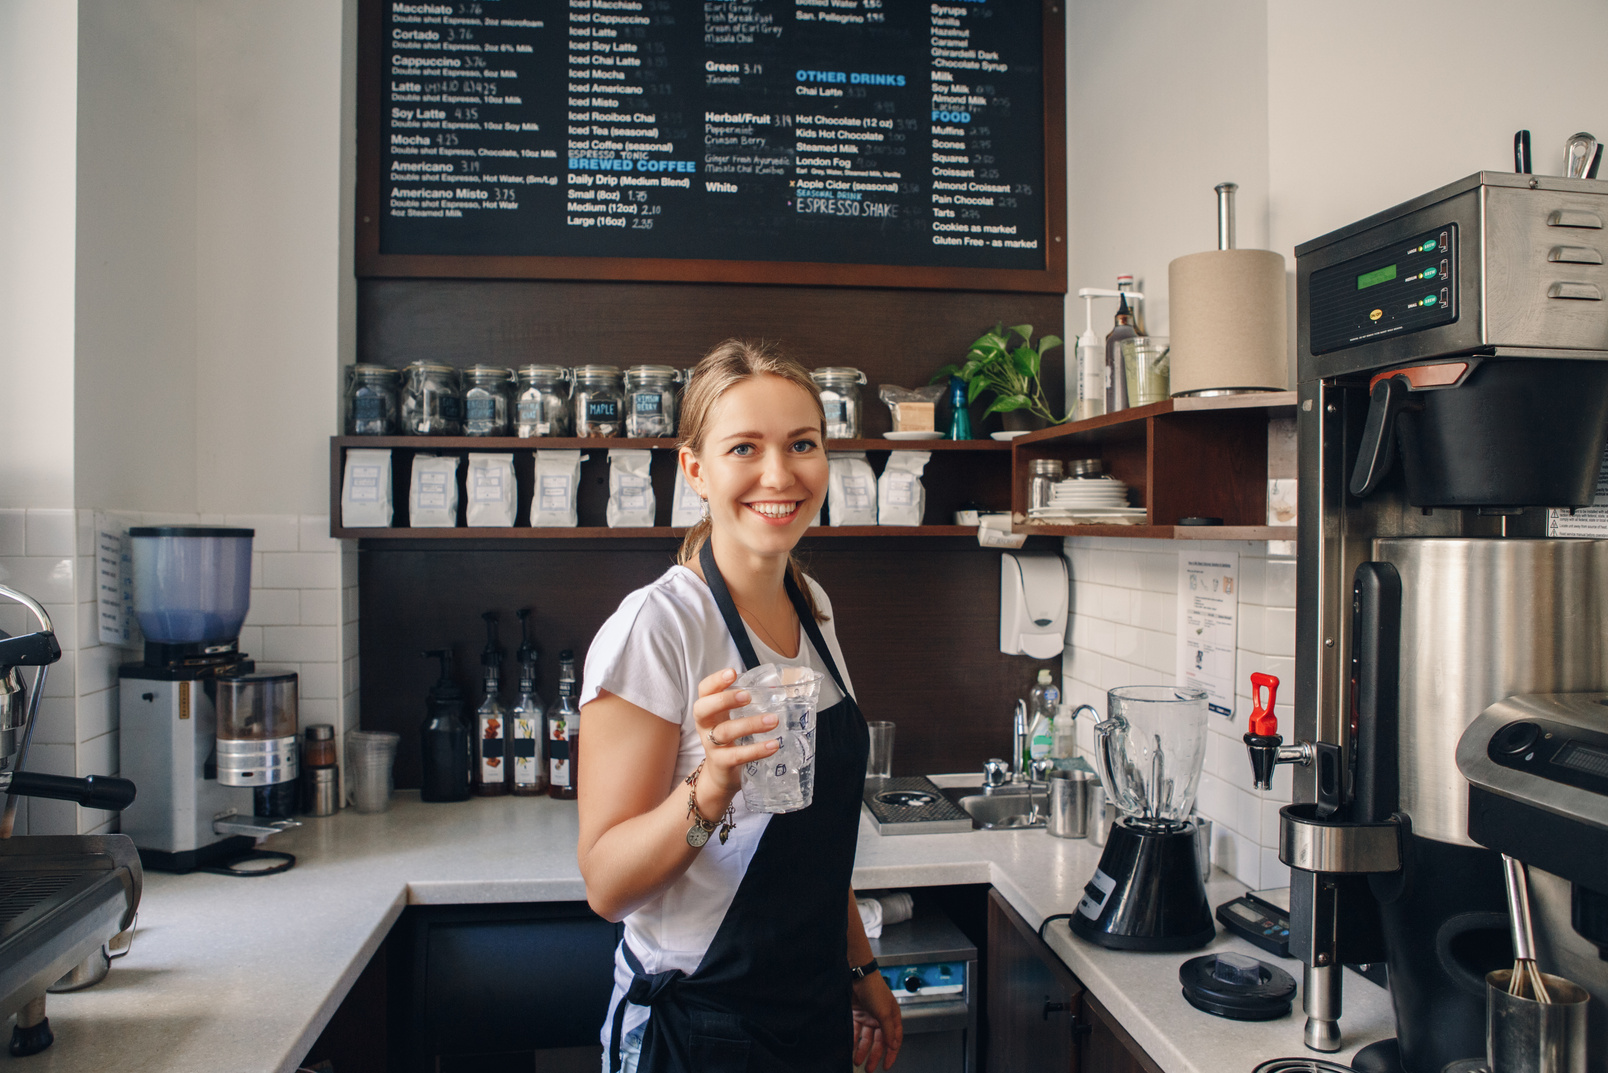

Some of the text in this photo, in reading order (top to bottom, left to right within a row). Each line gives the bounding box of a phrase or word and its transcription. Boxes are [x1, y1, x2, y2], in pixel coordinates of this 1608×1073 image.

[392, 3, 482, 15] Macchiato 3.76
[569, 0, 642, 10] Iced Macchiato
[704, 2, 753, 15] Earl Grey
[931, 4, 967, 16] Syrups
[569, 12, 650, 25] Iced Cappuccino
[705, 12, 773, 24] Irish Breakfast
[796, 10, 864, 24] San. Pellegrino
[931, 16, 960, 27] Vanilla
[392, 28, 474, 41] Cortado 3.76
[569, 26, 617, 38] Iced Latte
[732, 22, 740, 33] of
[742, 24, 759, 33] Earl
[761, 23, 782, 38] Grey
[931, 26, 970, 38] Hazelnut
[704, 33, 754, 43] Masala Chai
[931, 36, 968, 48] Caramel
[569, 40, 638, 53] Iced Soy Latte
[931, 47, 999, 60] Ghirardelli Dark
[392, 55, 486, 68] Cappuccino 3.76
[569, 54, 641, 66] Iced Chai Latte
[931, 58, 980, 70] -Chocolate
[981, 61, 1008, 73] Syrup
[705, 60, 762, 75] Green 3.19
[569, 69, 625, 80] Iced Mocha
[706, 74, 740, 86] Jasmine
[796, 70, 906, 86] OTHER DRINKS
[931, 70, 953, 82] Milk
[392, 81, 421, 91] Latte
[569, 82, 643, 94] Iced Americano
[796, 86, 843, 97] Chai Latte
[931, 83, 970, 94] Soy Milk
[569, 96, 619, 108] Iced Misto
[932, 94, 987, 106] Almond Milk
[392, 107, 478, 120] Soy Latte 4.35
[568, 111, 656, 123] Iced Rooibos Chai
[705, 112, 792, 127] Herbal/Fruit 3.19
[931, 111, 971, 123] FOOD
[796, 114, 893, 130] Hot Chocolate (12 oz)
[568, 125, 659, 138] Iced Tea (seasonal)
[705, 123, 754, 136] Peppermint
[796, 128, 884, 141] Kids Hot Chocolate
[931, 125, 965, 136] Muffins
[391, 133, 458, 145] Mocha 4.25
[741, 136, 766, 148] Berry
[932, 139, 966, 150] Scones
[568, 139, 673, 153] Iced Coffee (seasonal)
[796, 142, 837, 153] Steamed
[839, 144, 859, 153] Milk
[568, 150, 649, 160] ESPRESSO TONIC
[932, 152, 969, 164] Squares
[391, 160, 480, 172] Americano 3.19
[568, 158, 696, 173] BREWED COFFEE
[796, 156, 851, 169] London Fog
[932, 166, 974, 178] Croissant
[568, 173, 690, 188] Daily Drip (Medium Blend)
[796, 179, 899, 193] Apple Cider (seasonal)
[705, 181, 738, 193] White
[932, 181, 1011, 193] Almond Croissant
[391, 187, 515, 200] Americano Misto 3.75
[568, 189, 620, 201] Small (8oz)
[796, 189, 862, 200] SEASONAL DRINK
[932, 194, 994, 206] Pain Chocolat
[407, 209, 444, 217] Steamed
[567, 202, 661, 215] Medium (12oz) 2.10
[796, 198, 899, 218] ESPRESSO SHAKE
[932, 208, 955, 218] Tarts
[567, 216, 595, 227] Large
[597, 216, 626, 228] (16oz)
[932, 221, 1017, 234] Cookies as marked
[932, 235, 962, 245] Gluten
[964, 236, 984, 246] Free
[1004, 239, 1037, 249] marked
[1424, 242, 1436, 250] BREW
[590, 404, 614, 415] MAPLE
